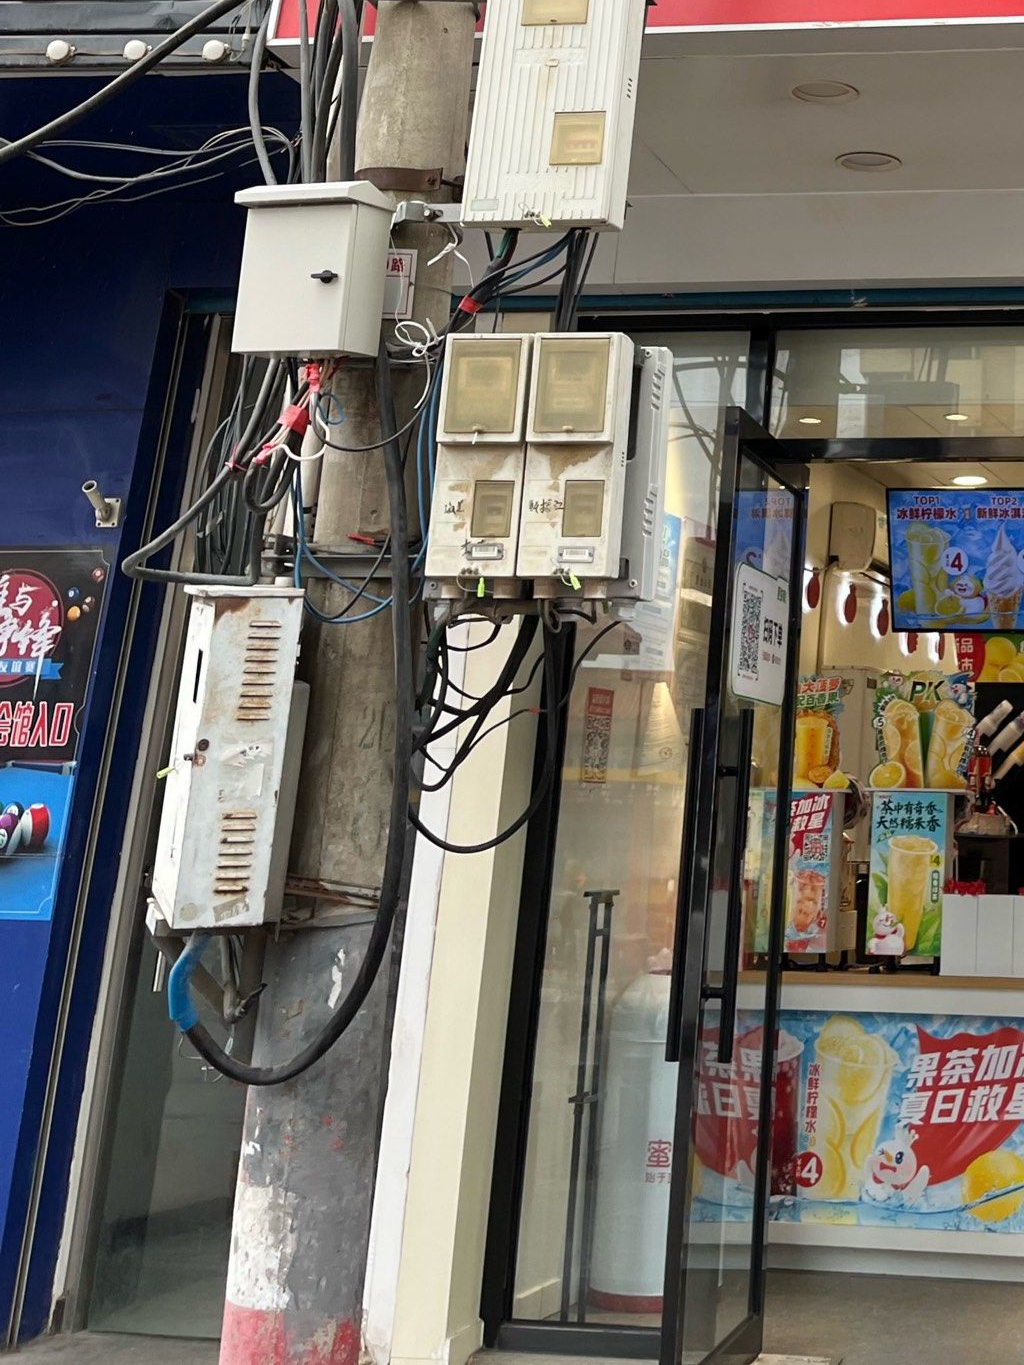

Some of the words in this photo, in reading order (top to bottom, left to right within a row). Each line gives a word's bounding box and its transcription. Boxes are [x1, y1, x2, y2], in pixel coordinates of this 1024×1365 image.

[913, 496, 940, 505] TOP1
[991, 497, 1017, 506] TOP2
[897, 507, 957, 519] 冰鲜柠檬水
[957, 638, 973, 653] 品
[909, 680, 944, 701] PK
[804, 1062, 821, 1134] 冰鲜柠檬水
[645, 1171, 672, 1184] 始于
